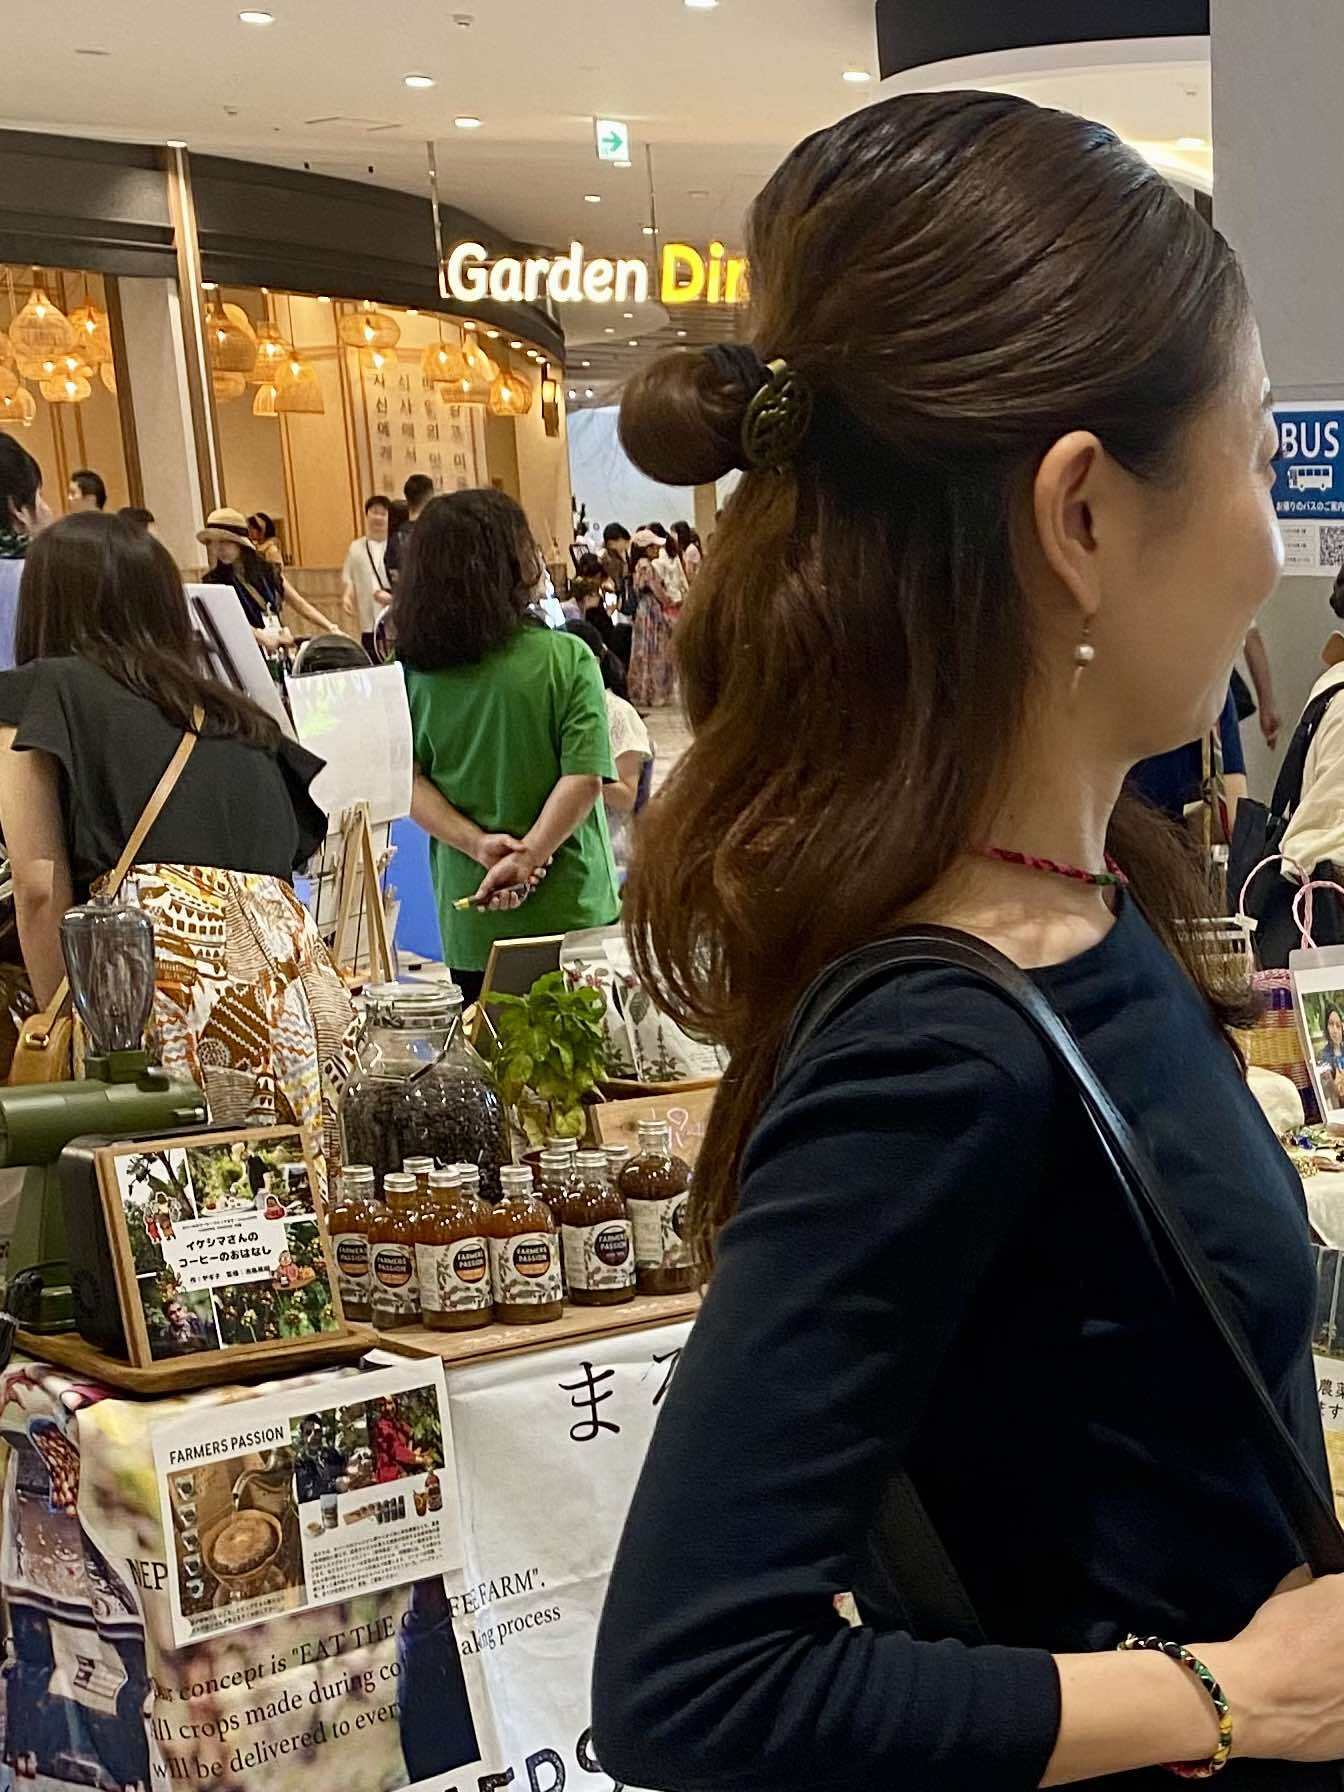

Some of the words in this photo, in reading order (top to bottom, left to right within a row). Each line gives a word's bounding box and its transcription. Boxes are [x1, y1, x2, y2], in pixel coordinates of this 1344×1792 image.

[447, 241, 648, 303] Garden
[1281, 421, 1340, 459] BUS
[178, 1247, 272, 1268] コーヒーのおはなし
[186, 1231, 259, 1251] イケシマさんの
[169, 1439, 228, 1465] FARMERS
[231, 1426, 285, 1451] PASSION
[179, 1663, 264, 1702] concept
[271, 1654, 287, 1674] is
[346, 1614, 395, 1652] THE
[179, 1712, 240, 1746] crops
[246, 1692, 303, 1727] made
[309, 1670, 374, 1707] during
[497, 1604, 561, 1636] process
[196, 1758, 223, 1780] be
[230, 1723, 328, 1773] delivered
[332, 1718, 351, 1739] to
